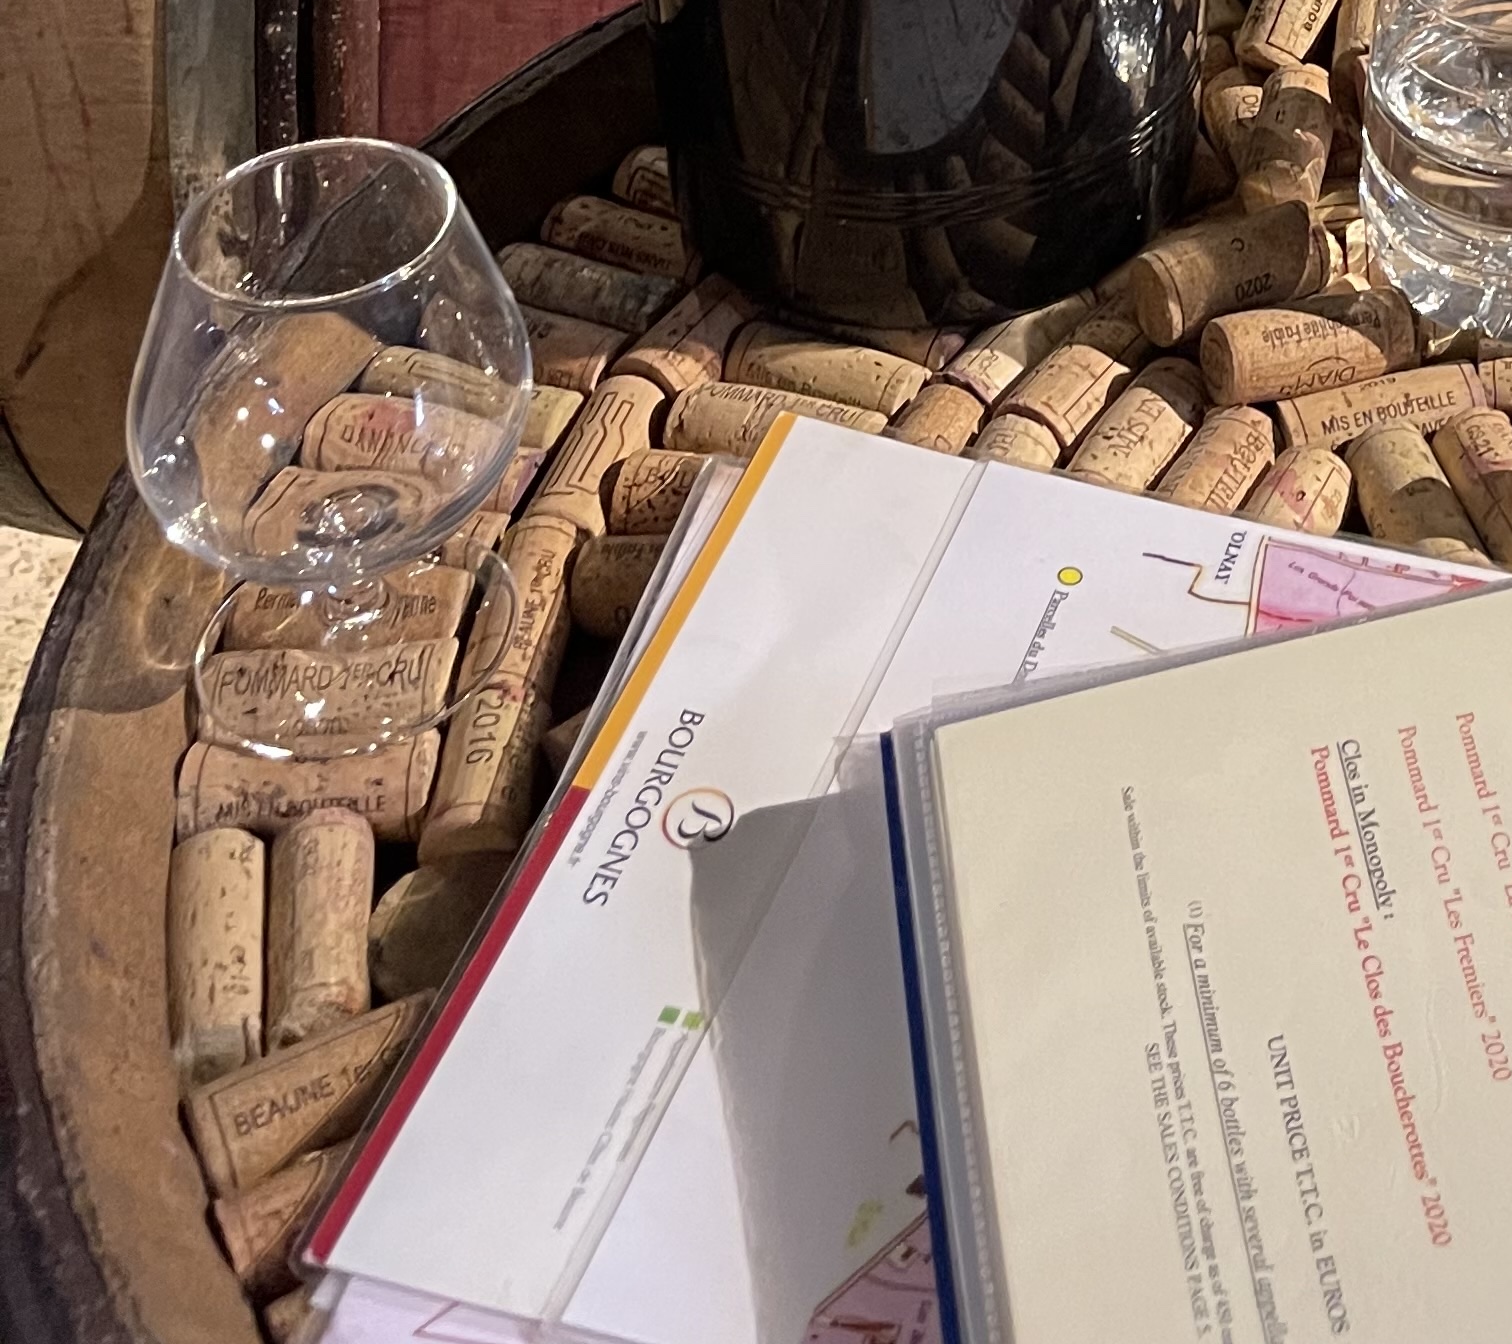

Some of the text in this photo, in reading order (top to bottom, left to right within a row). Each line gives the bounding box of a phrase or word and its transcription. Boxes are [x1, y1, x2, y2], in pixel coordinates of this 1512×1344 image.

[1231, 271, 1274, 302] 2020
[1110, 414, 1150, 461] MIS
[1320, 387, 1456, 437] MIS EN BOUTEILLE
[1024, 588, 1070, 659] Parcelles du
[465, 698, 503, 766] 2016
[582, 708, 706, 908] BOURGOGNES
[1310, 744, 1351, 841] Pommard
[1455, 711, 1498, 801] Pommard
[1490, 831, 1511, 871] Cru
[1335, 738, 1397, 912] Clos in Monopoly
[1341, 873, 1362, 915] Cru
[1397, 724, 1440, 814] Pommard
[1430, 845, 1452, 886] Cru
[1442, 887, 1464, 930] "Les
[1480, 1029, 1512, 1082] 2020
[1182, 922, 1206, 959] For
[1352, 915, 1374, 952] "Le
[1188, 957, 1207, 976] a
[1360, 954, 1385, 1002] Clos
[1192, 973, 1223, 1059] minimum
[1372, 1004, 1395, 1039] des
[1143, 1042, 1164, 1075] SEE
[1209, 1057, 1235, 1082] of
[1150, 1074, 1170, 1110] THE
[1381, 1040, 1438, 1188] Boucherottes"
[1156, 1110, 1180, 1165] SALES
[1216, 1096, 1247, 1160] bottles
[1267, 1033, 1351, 1336] UNIT PRICE T.T.C. in EUROS
[1420, 1192, 1453, 1248] 2020
